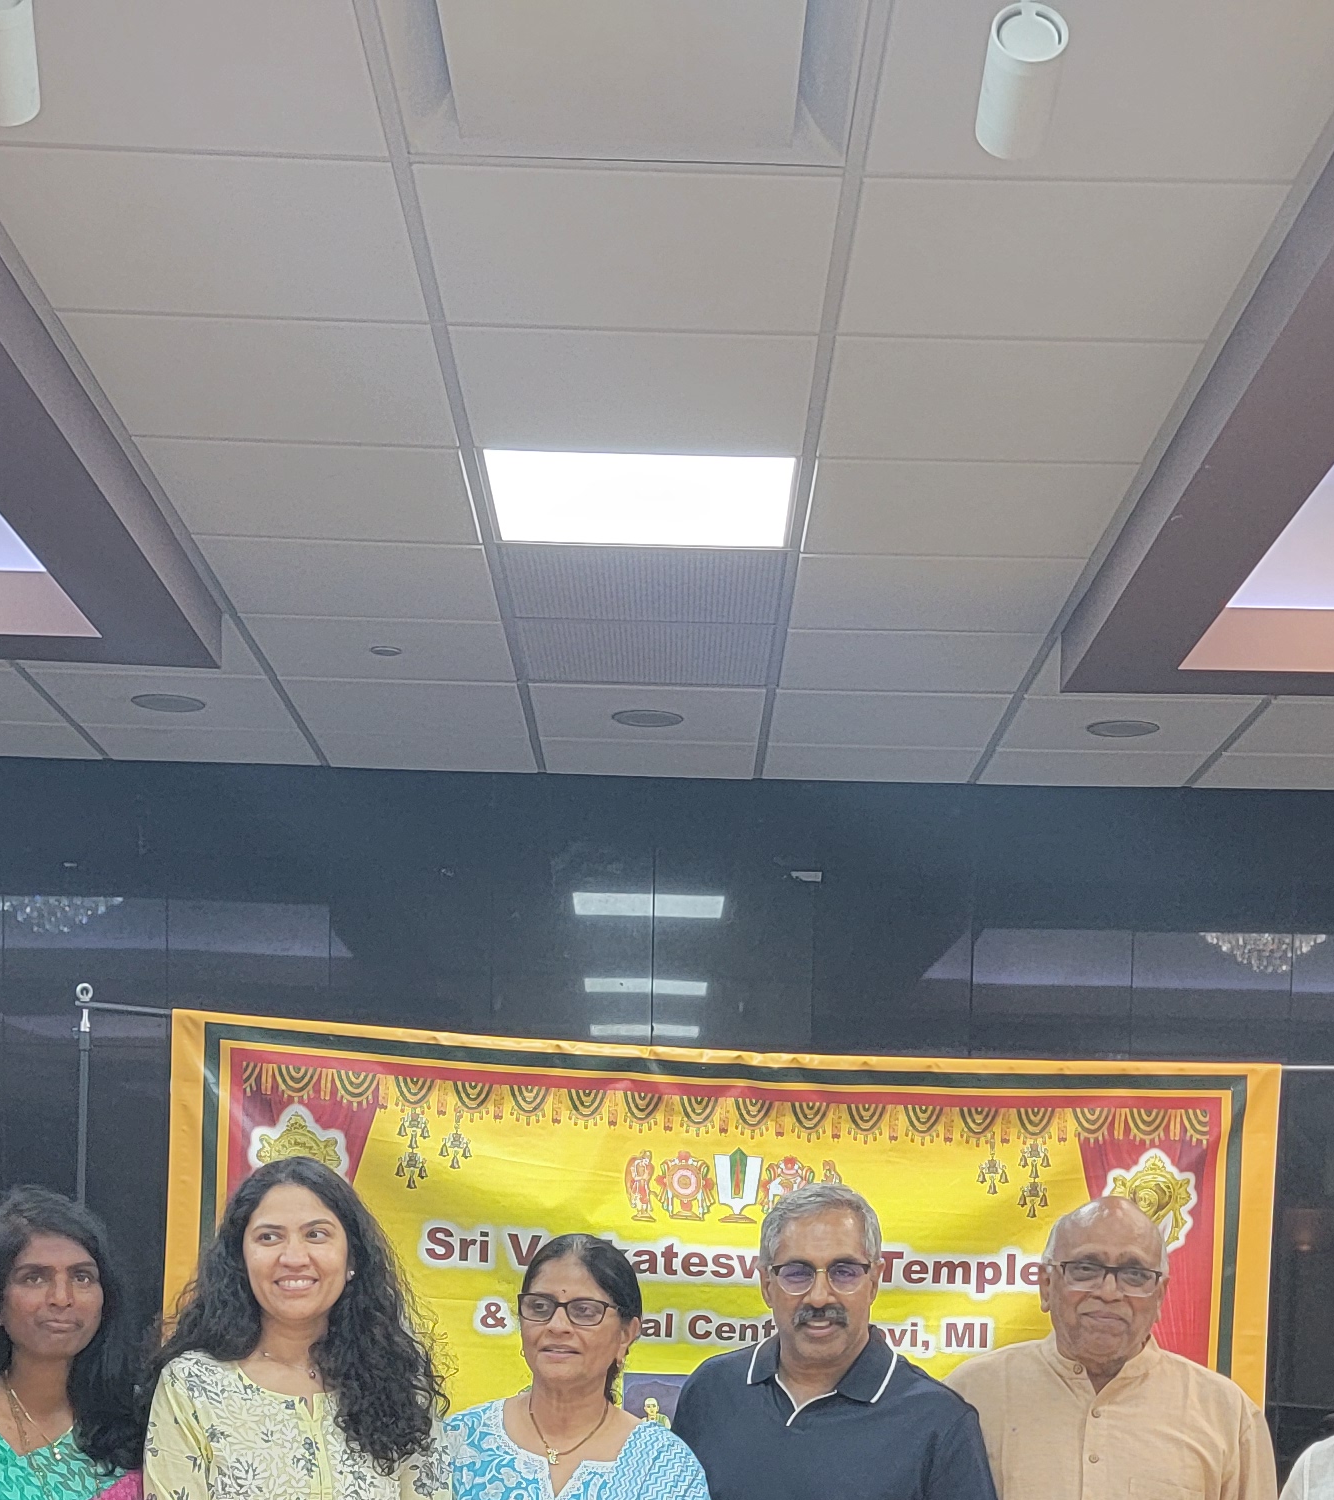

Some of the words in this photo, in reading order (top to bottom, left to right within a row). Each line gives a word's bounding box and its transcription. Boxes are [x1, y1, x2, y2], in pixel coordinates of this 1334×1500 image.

[425, 1227, 489, 1264] Sri
[881, 1251, 1041, 1293] Temple
[480, 1302, 507, 1329] &
[688, 1314, 776, 1342] Cent
[945, 1322, 987, 1349] MI
